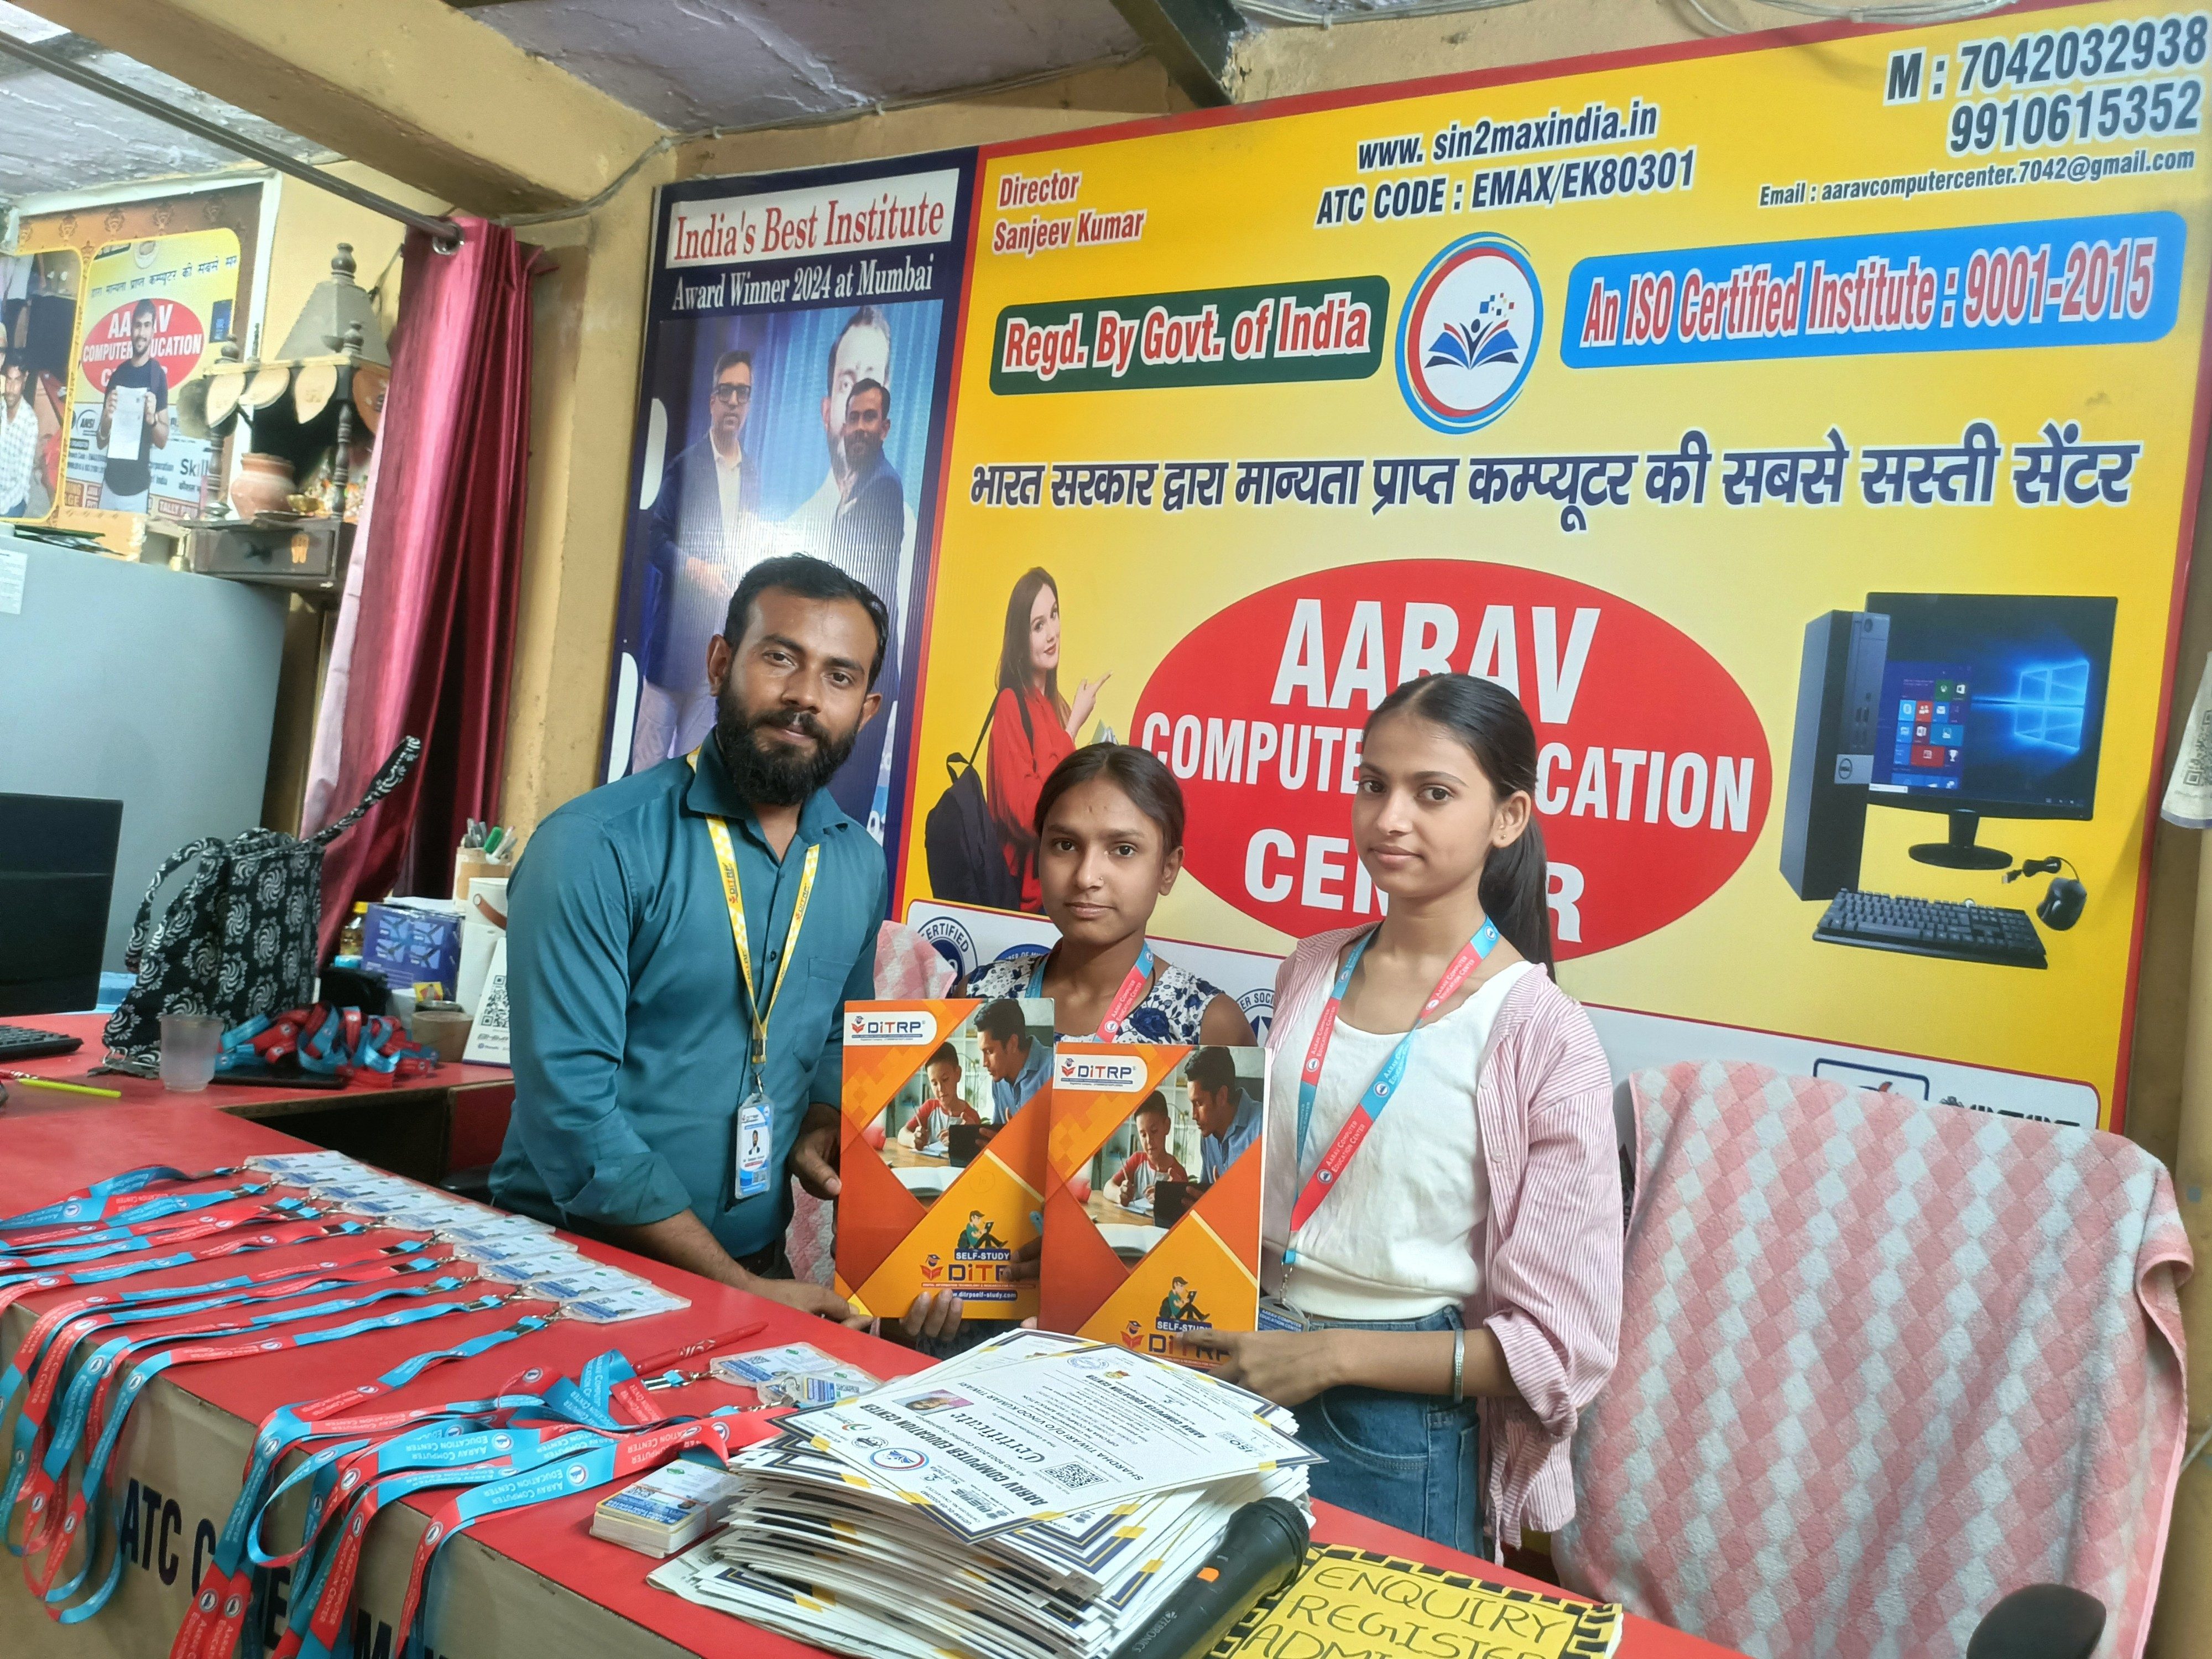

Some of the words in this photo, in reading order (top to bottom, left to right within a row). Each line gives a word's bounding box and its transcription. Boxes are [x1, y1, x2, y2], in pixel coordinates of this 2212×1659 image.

[1887, 54, 1922, 101] M
[1959, 15, 2208, 93] 7042032938
[1358, 139, 1423, 170] www.
[1433, 98, 1658, 159] sin2maxindia.in
[1949, 80, 2201, 153] 9910615352
[998, 170, 1080, 208] Director
[1315, 189, 1365, 226] ATC
[1373, 178, 1446, 220] CODE
[1472, 150, 1694, 209] EMAX/EK80301
[1760, 183, 1806, 206] Email
[1821, 150, 2195, 201] aaravcomputercenter.7042@gmail.com
[674, 208, 755, 262] India's
[761, 204, 818, 254] Best
[826, 192, 945, 246] Institute
[993, 216, 1072, 253] Sanjeev
[1076, 209, 1145, 243] Kumar
[672, 274, 725, 311] Award
[729, 269, 790, 306] Winner
[792, 265, 831, 301] 2024
[834, 268, 853, 295] at
[856, 254, 933, 295] Mumbai
[1580, 276, 1621, 346] An
[1624, 272, 1674, 345] ISO
[1679, 260, 1802, 341] Certified
[1807, 253, 1937, 333] Institute
[1964, 238, 2157, 325] 9001-2015
[107, 304, 173, 339] AAV
[1002, 314, 1085, 379] Regd.
[1096, 311, 1136, 375] By
[1143, 305, 1222, 361] Govt.
[1234, 299, 1274, 361] of
[1274, 293, 1371, 358] India
[150, 334, 202, 358] UCATION
[971, 462, 1045, 507] भारत
[1050, 462, 1159, 507] सरकार
[1162, 461, 1229, 512] द्वारा
[1235, 459, 1364, 507] मान्यता
[1371, 457, 1460, 517] प्राप्त
[1468, 455, 1639, 532] कम्प्यूटर
[1645, 430, 1712, 505] की
[1721, 426, 1853, 505] सबसे
[1860, 421, 2001, 505] सस्ती
[2012, 422, 2141, 507] सेंटर
[1270, 598, 1601, 725] AARAV
[1141, 711, 1364, 795] COMPUTE
[1536, 742, 1755, 833] CATION
[922, 923, 969, 953] ERTIFIED
[956, 1252, 1010, 1260] SELF-STUDY
[956, 1382, 989, 1396] TIWARI
[1084, 1374, 1113, 1386] CENTER
[1107, 1385, 1147, 1405] EDUCATION
[858, 1404, 903, 1422] CENTER
[984, 1395, 1020, 1410] KUMAR
[1014, 1409, 1048, 1424] VINOD
[1141, 1404, 1184, 1425] COMPUTER
[893, 1420, 956, 1449] EDUCATION
[945, 1412, 1050, 1464] Certificate
[1061, 1434, 1099, 1453] TIWARI
[1177, 1424, 1208, 1438] AARAV
[943, 1447, 1011, 1482] COMPUTER
[1093, 1453, 1145, 1480] SHARDHA
[999, 1481, 1050, 1506] AARAV
[120, 1478, 182, 1586] ATC
[1314, 1567, 1567, 1644] ENQUIRY
[1131, 1616, 1171, 1653] ZEBRONICS
